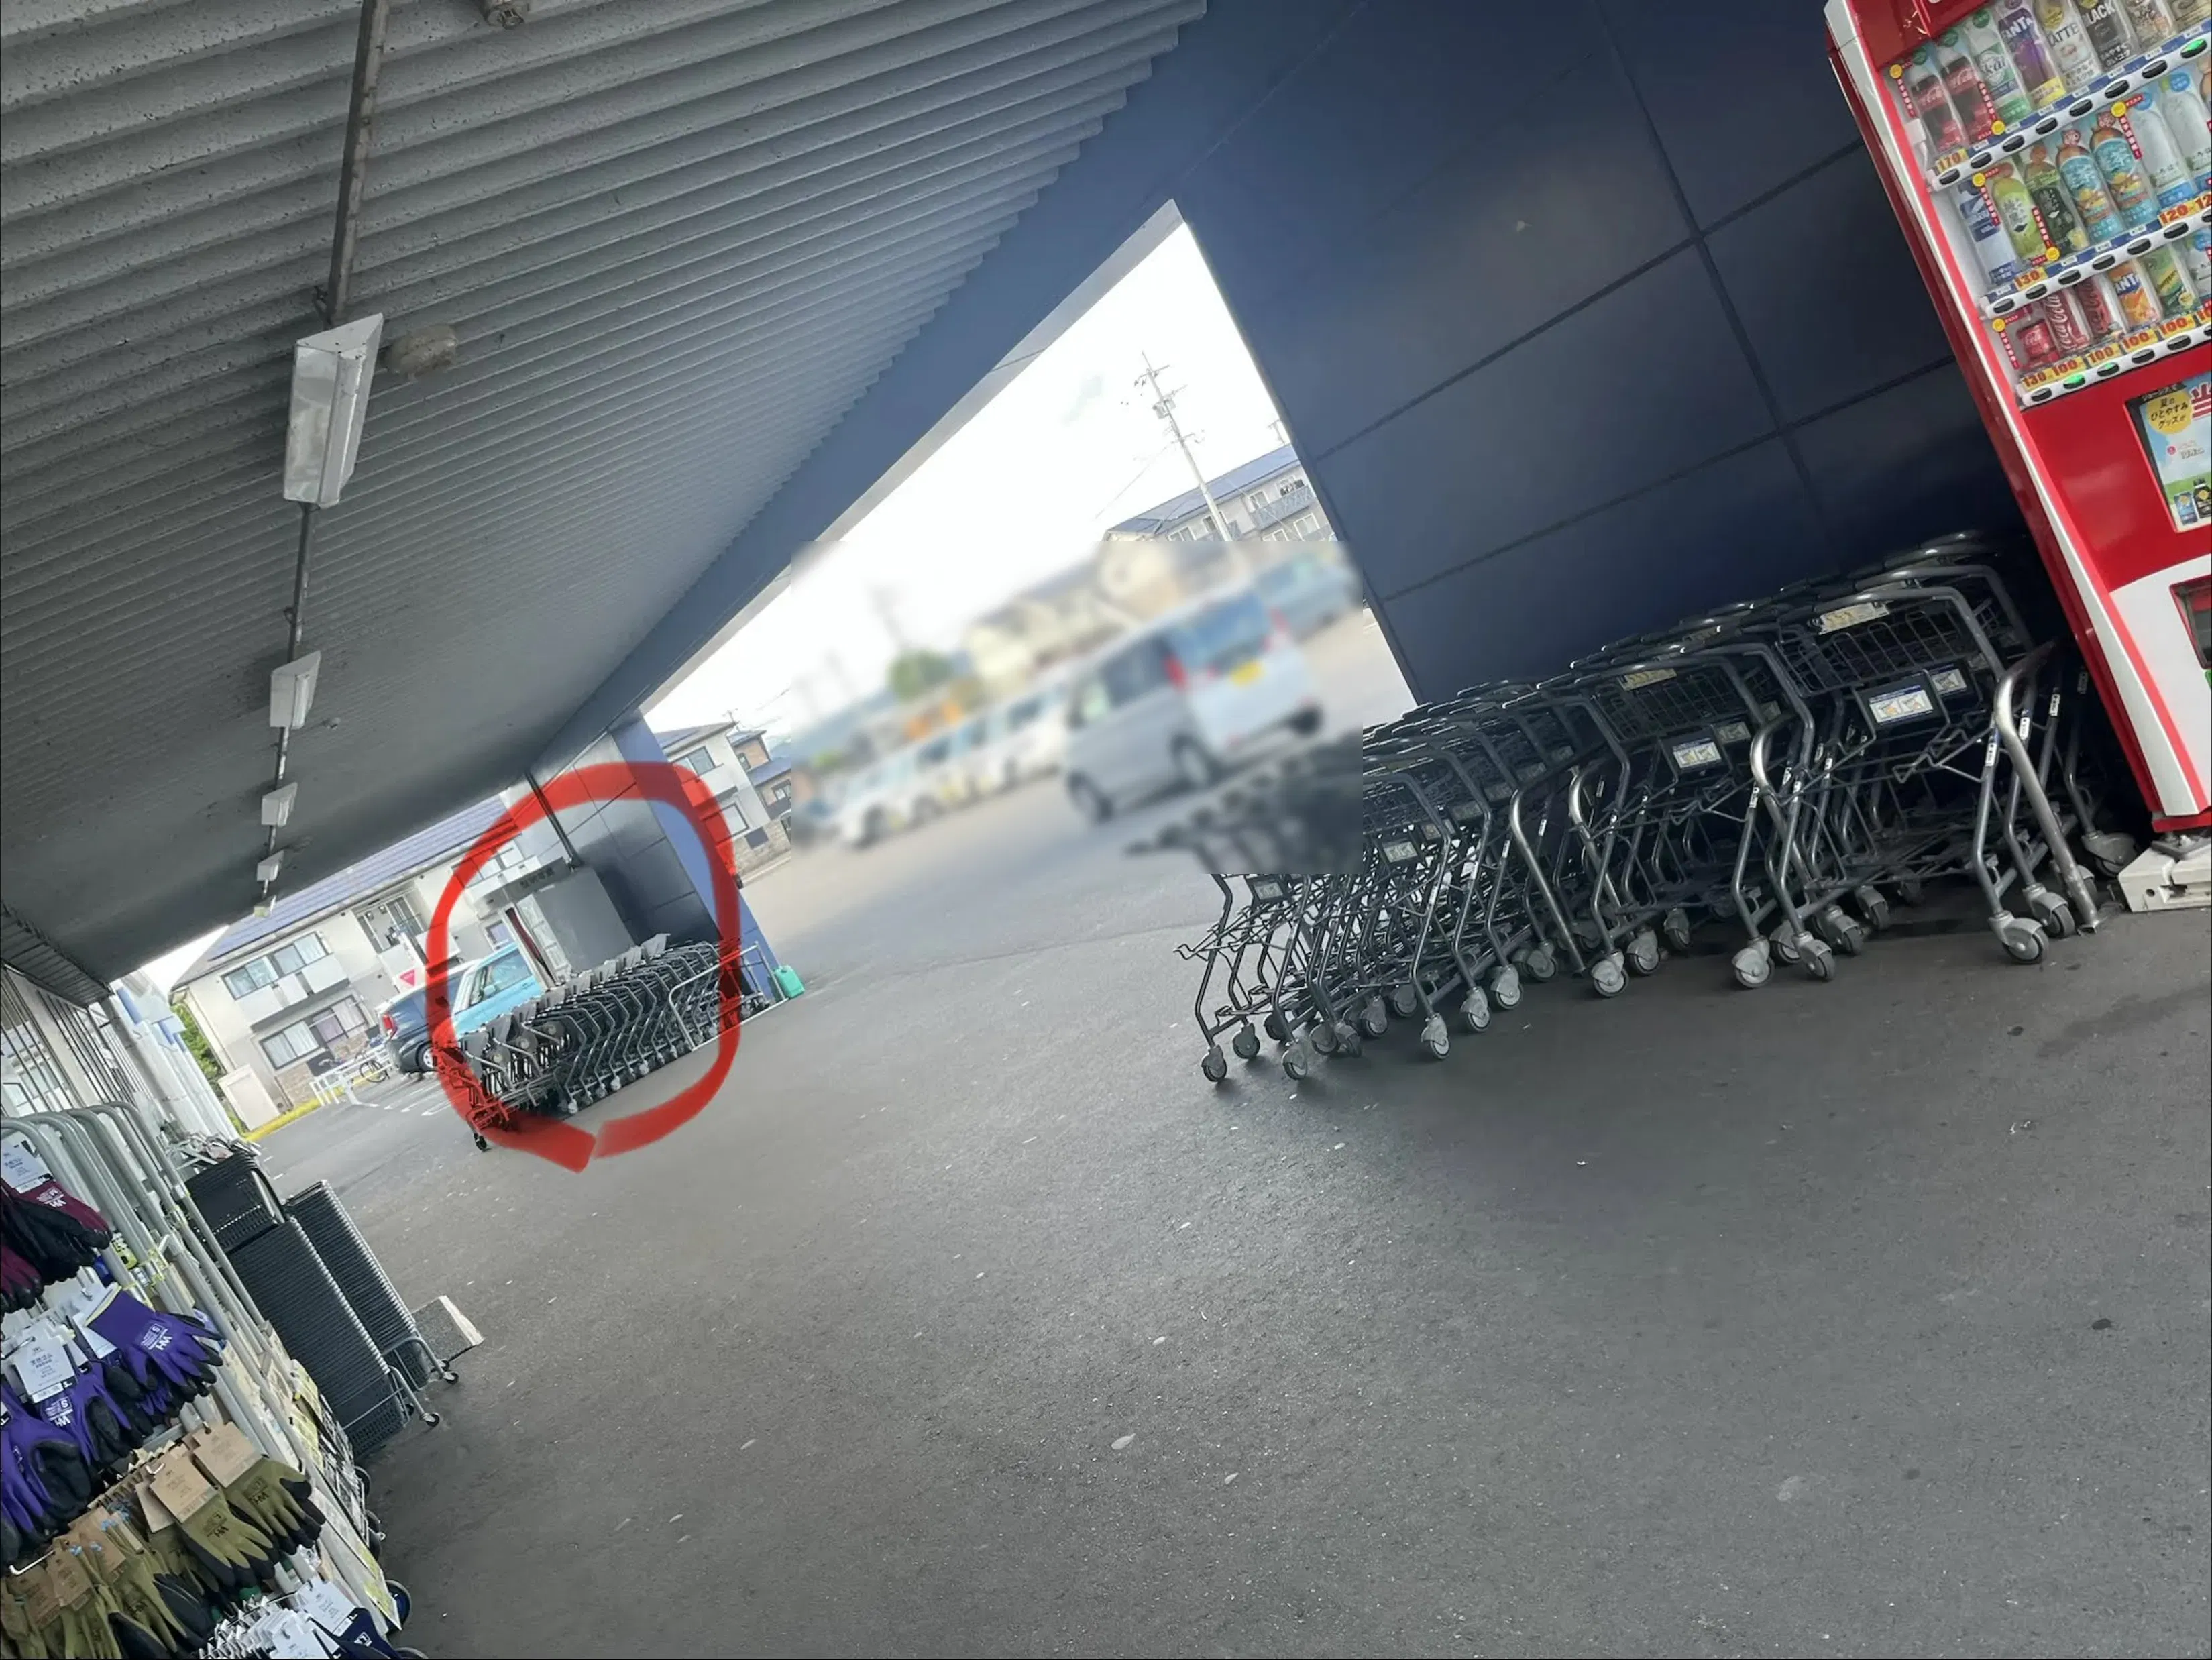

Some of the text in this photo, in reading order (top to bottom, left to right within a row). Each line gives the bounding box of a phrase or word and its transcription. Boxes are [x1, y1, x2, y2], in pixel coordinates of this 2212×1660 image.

[2150, 403, 2189, 422] ひとやすみ
